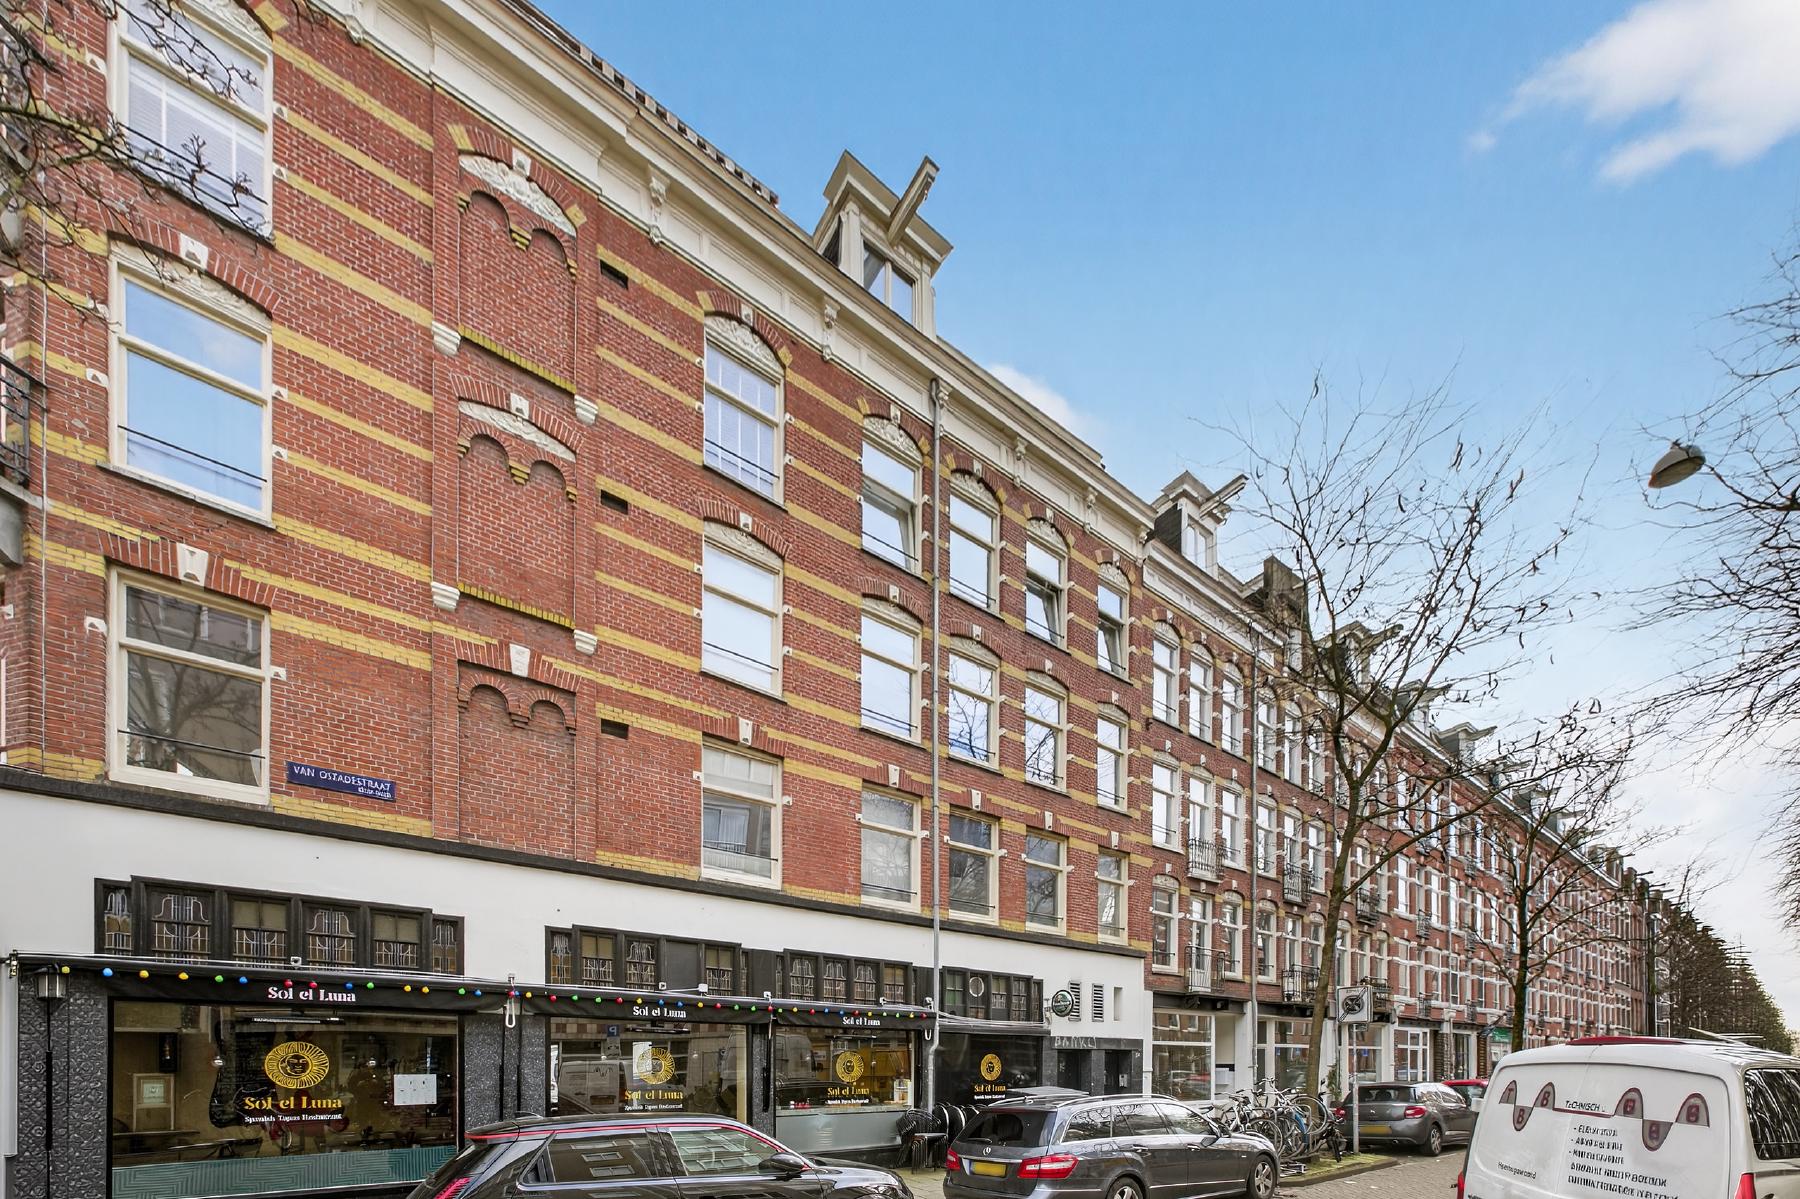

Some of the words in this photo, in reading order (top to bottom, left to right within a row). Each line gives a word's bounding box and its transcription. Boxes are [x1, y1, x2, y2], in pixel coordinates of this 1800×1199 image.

[293, 766, 315, 777] VAN
[319, 770, 391, 791] OSTADESTRAAT
[267, 986, 293, 1000] Sol
[299, 988, 313, 1000] el
[319, 989, 356, 1002] Luna
[632, 1005, 648, 1016] Sol
[652, 1007, 660, 1017] el
[664, 1008, 686, 1018] Luna
[624, 1090, 641, 1100] Sol
[645, 1090, 655, 1100] el
[659, 1090, 684, 1100] Luna
[243, 1096, 272, 1110] Sol
[279, 1096, 294, 1109] el
[301, 1096, 342, 1109] Luna
